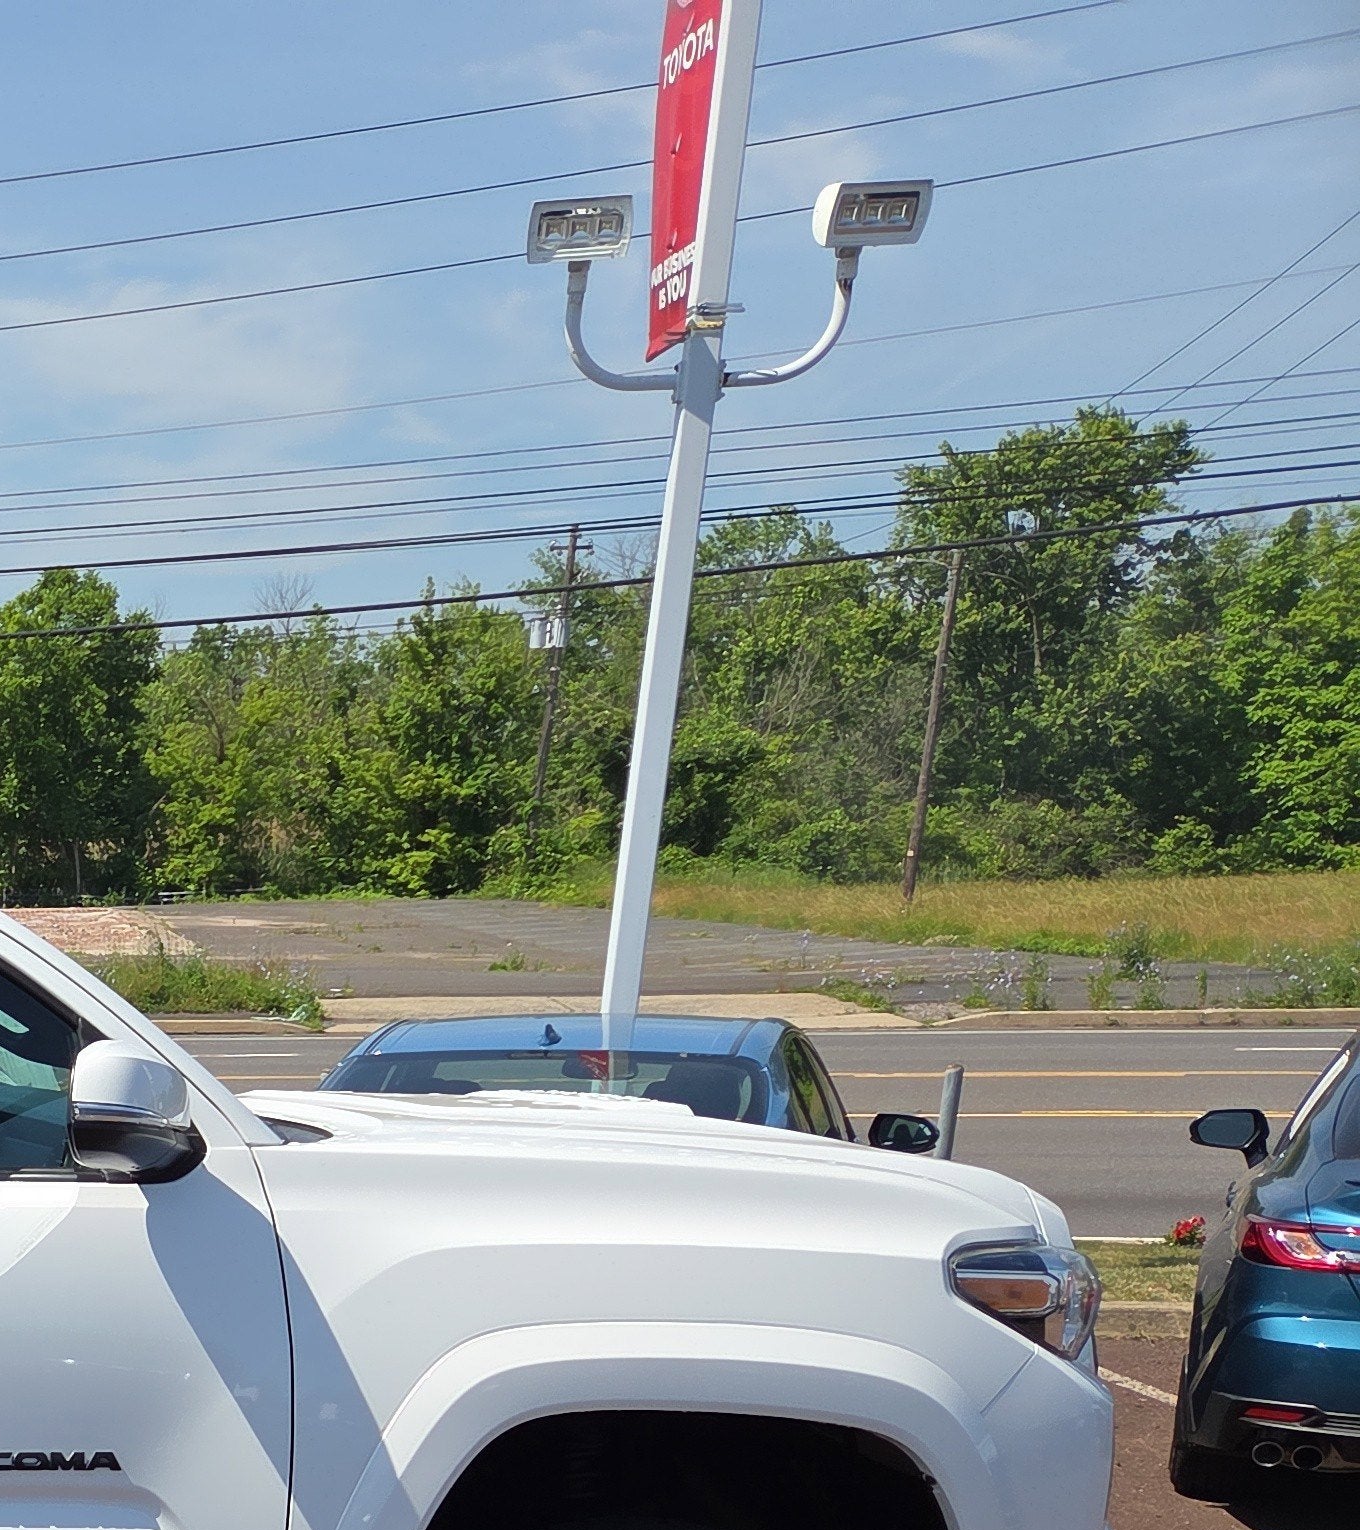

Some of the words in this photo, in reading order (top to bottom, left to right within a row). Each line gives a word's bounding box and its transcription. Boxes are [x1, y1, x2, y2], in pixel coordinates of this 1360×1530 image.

[662, 17, 714, 90] TOYOTA
[663, 241, 696, 280] BUSINES
[666, 269, 687, 305] YOU
